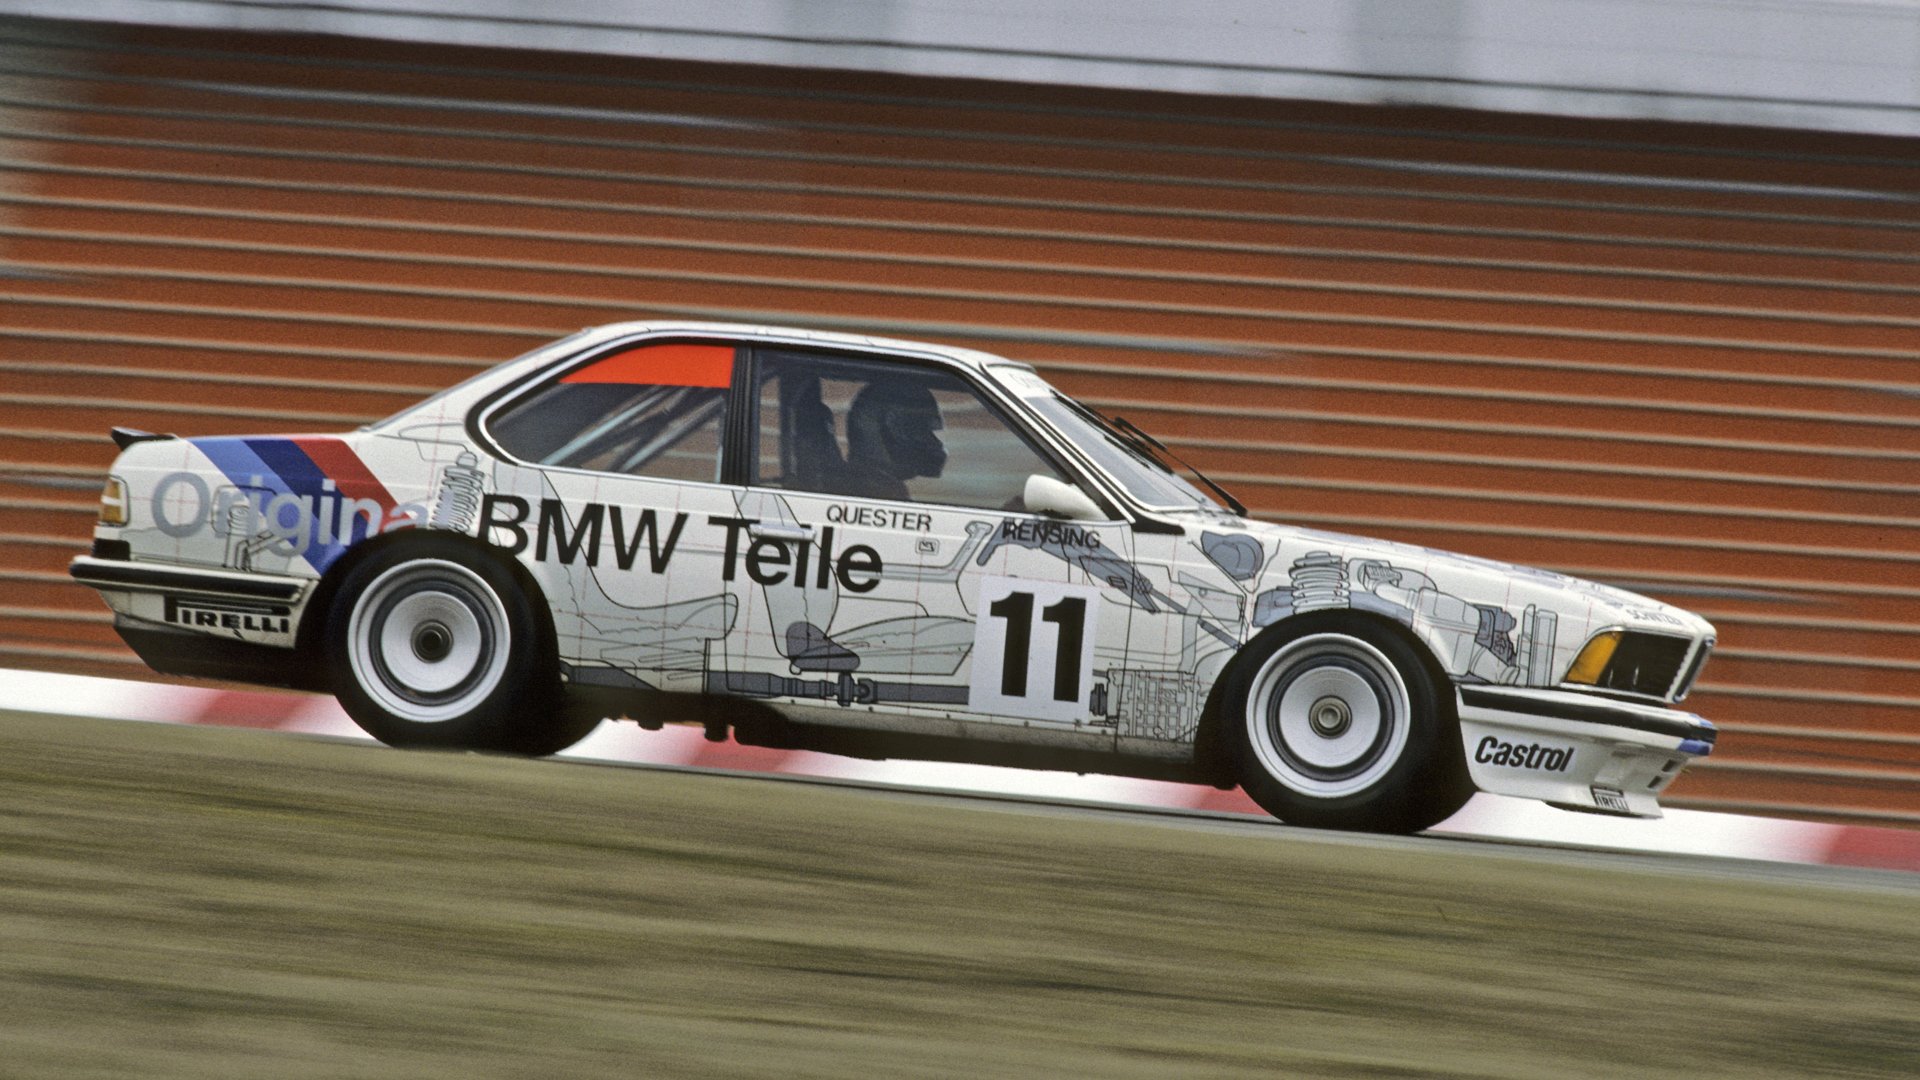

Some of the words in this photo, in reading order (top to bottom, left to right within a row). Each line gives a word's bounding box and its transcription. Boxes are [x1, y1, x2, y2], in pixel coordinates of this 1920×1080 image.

[826, 504, 933, 533] QUESTER
[1001, 520, 1102, 549] RENSING
[478, 494, 689, 575] BMW
[708, 516, 884, 594] Teile
[164, 594, 291, 634] PIRELLI
[989, 590, 1088, 703] 11
[1474, 735, 1575, 773] Castrol
